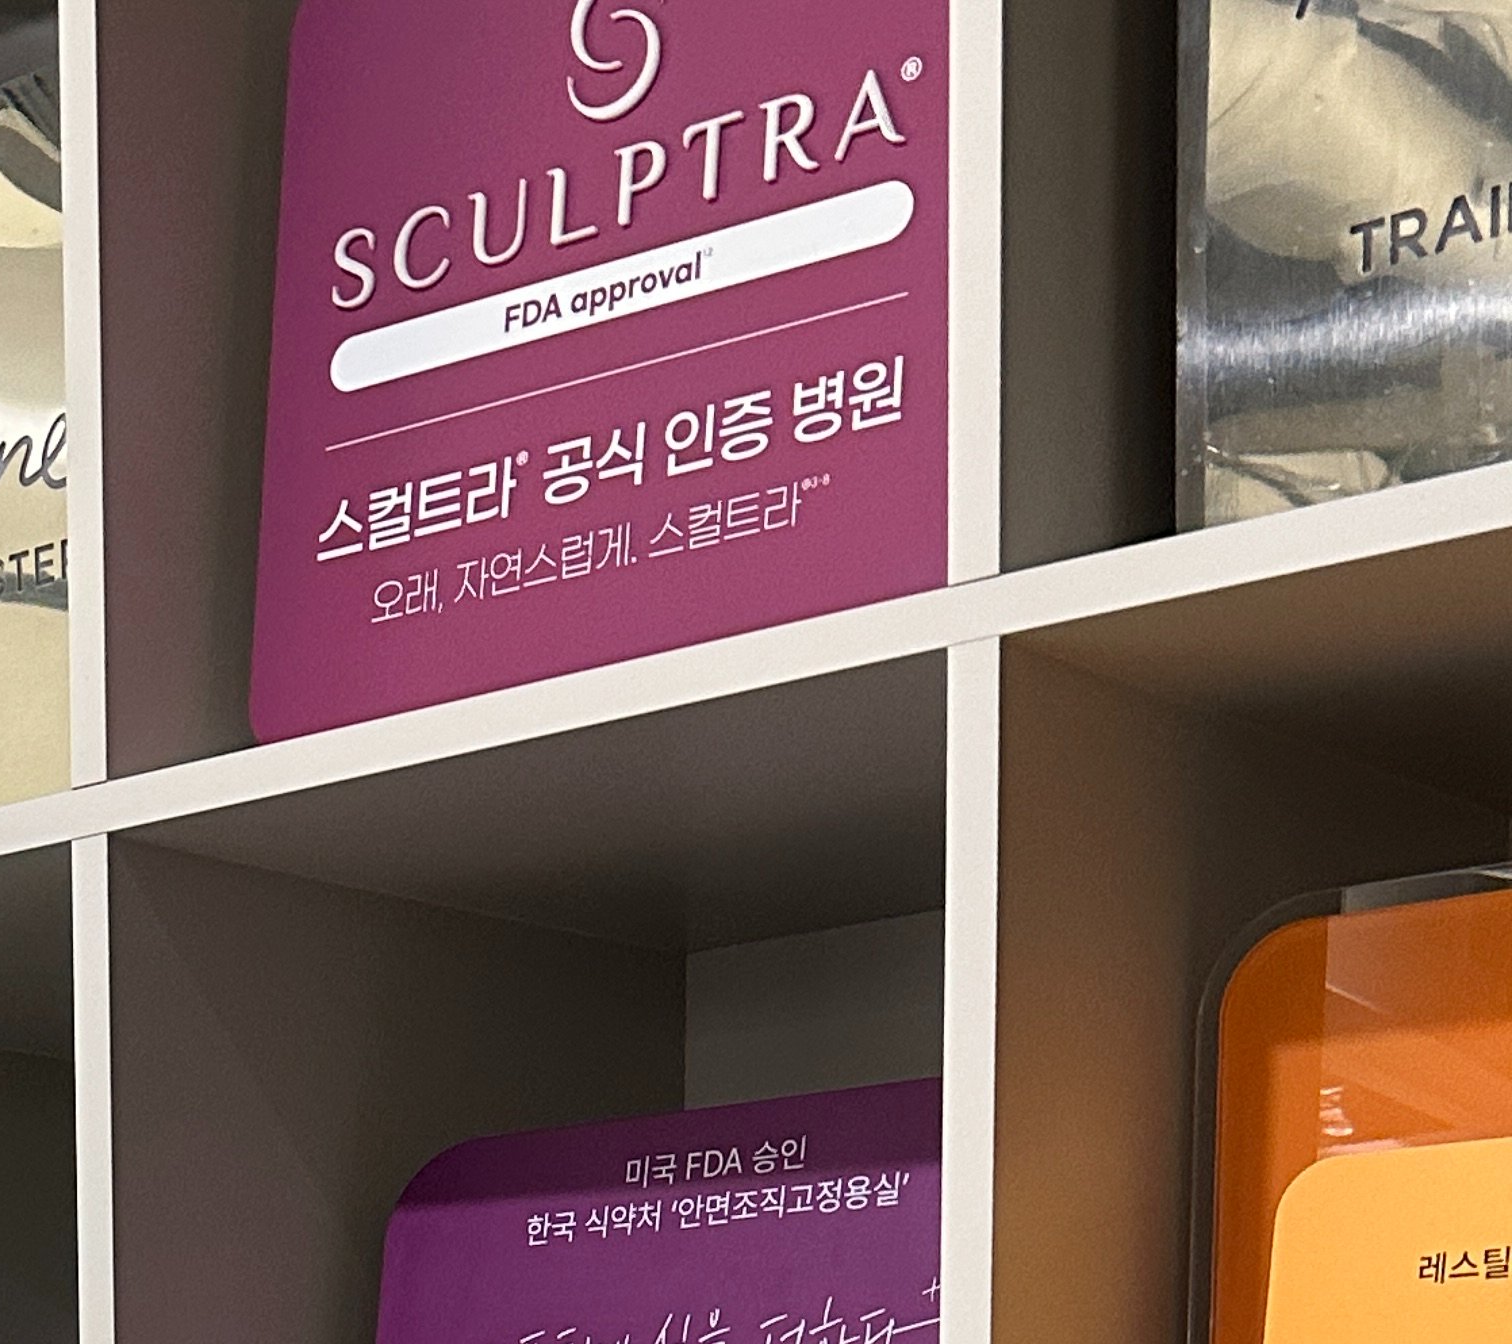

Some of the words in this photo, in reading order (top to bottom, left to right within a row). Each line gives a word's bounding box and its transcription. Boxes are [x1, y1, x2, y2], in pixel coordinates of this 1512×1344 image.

[503, 293, 563, 334] FDA
[542, 420, 647, 506] 공식
[665, 388, 775, 478] 인증
[791, 354, 906, 444] 병원
[370, 568, 446, 624] 오래,
[452, 521, 639, 604] 자연스럽게.
[624, 1152, 678, 1188] 미국
[685, 1147, 743, 1182] FDA
[751, 1135, 808, 1176] 승인
[525, 1211, 578, 1248] 한국
[584, 1199, 663, 1240] 식약처
[1418, 1244, 1512, 1285] 레스틸
